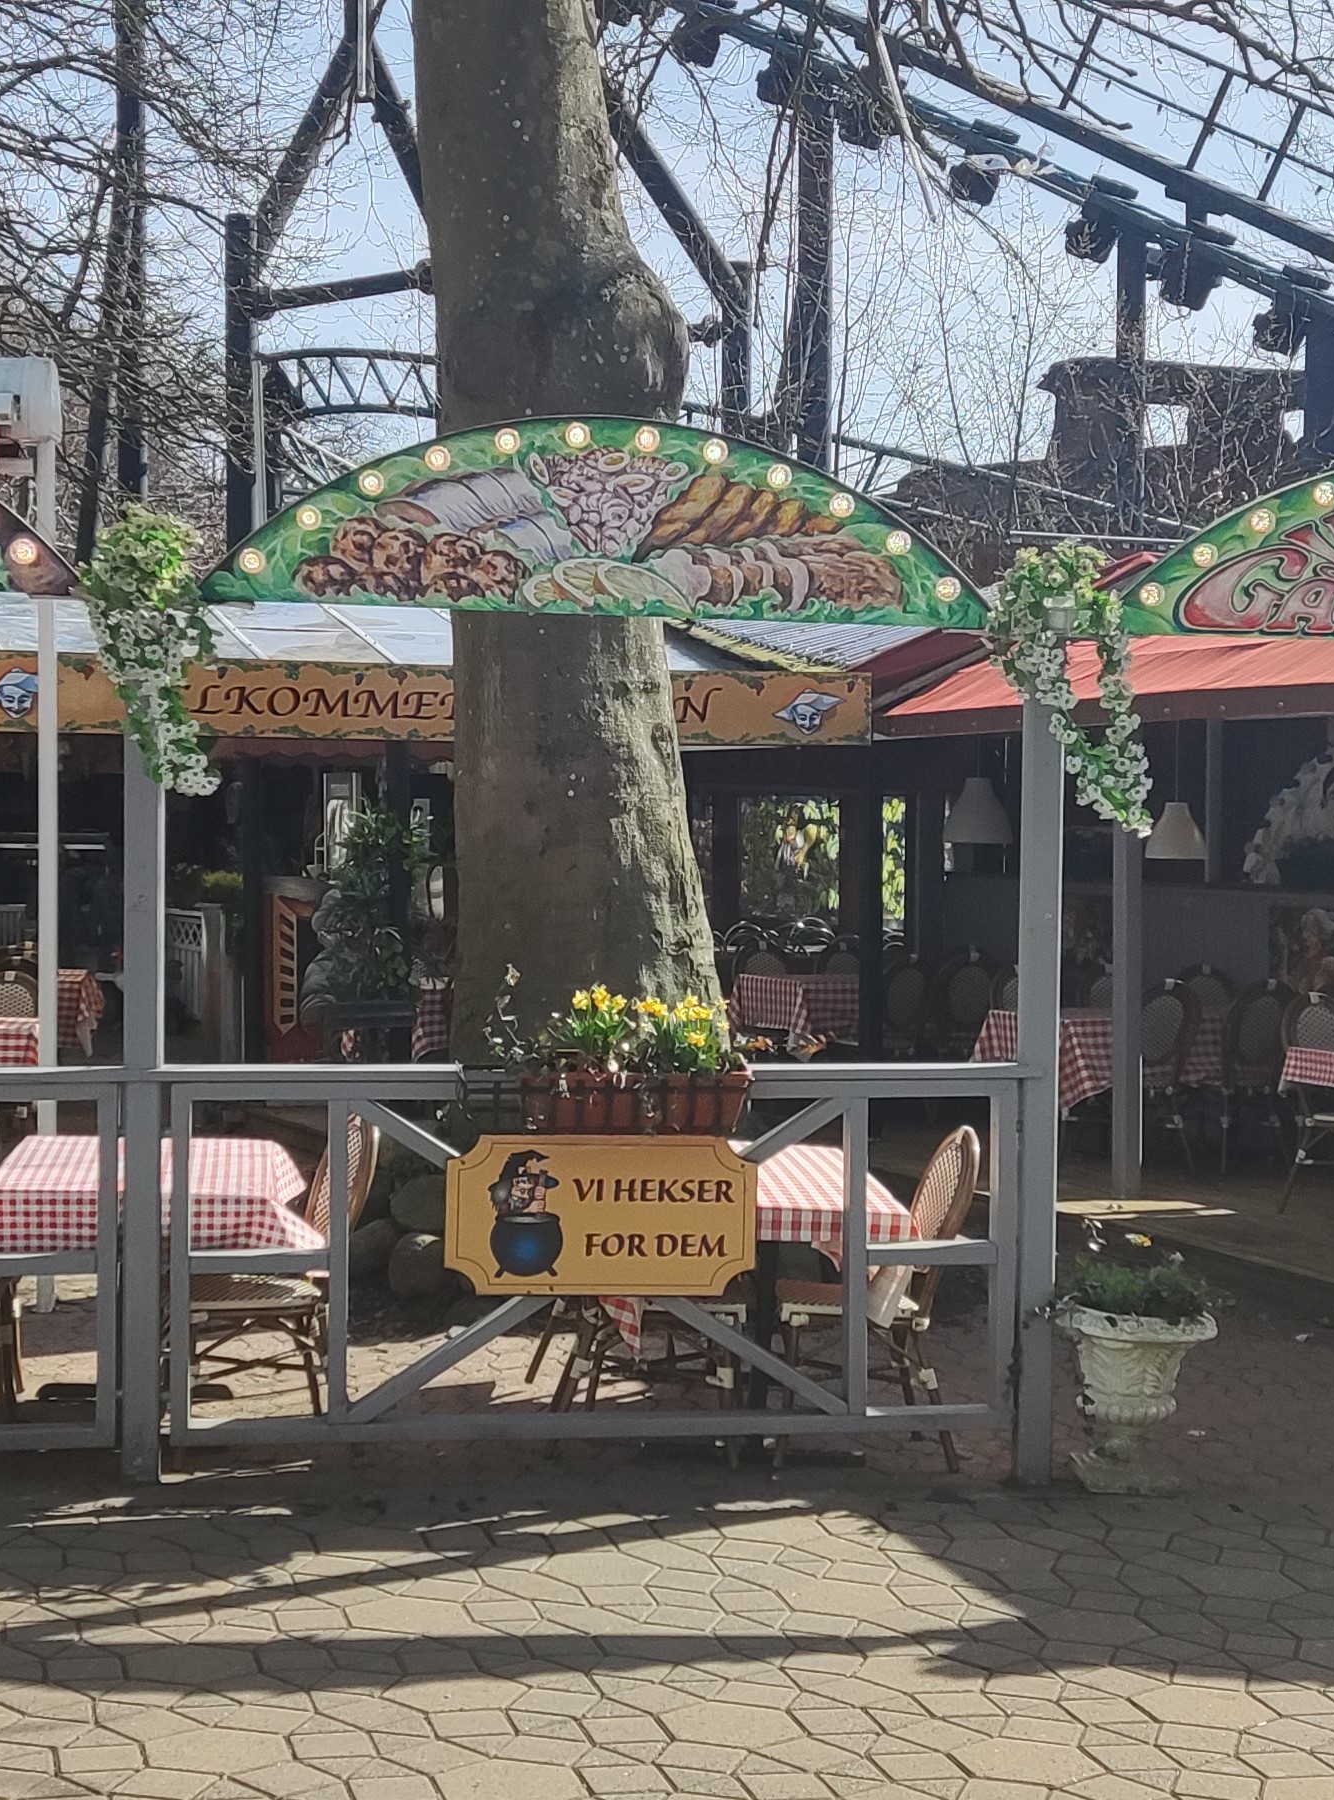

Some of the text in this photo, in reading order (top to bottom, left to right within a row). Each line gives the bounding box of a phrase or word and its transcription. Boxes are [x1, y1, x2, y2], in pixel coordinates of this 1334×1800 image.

[183, 684, 455, 720] LKOMME
[572, 1178, 735, 1204] VI HEKSER
[585, 1233, 728, 1257] FOR DEM
